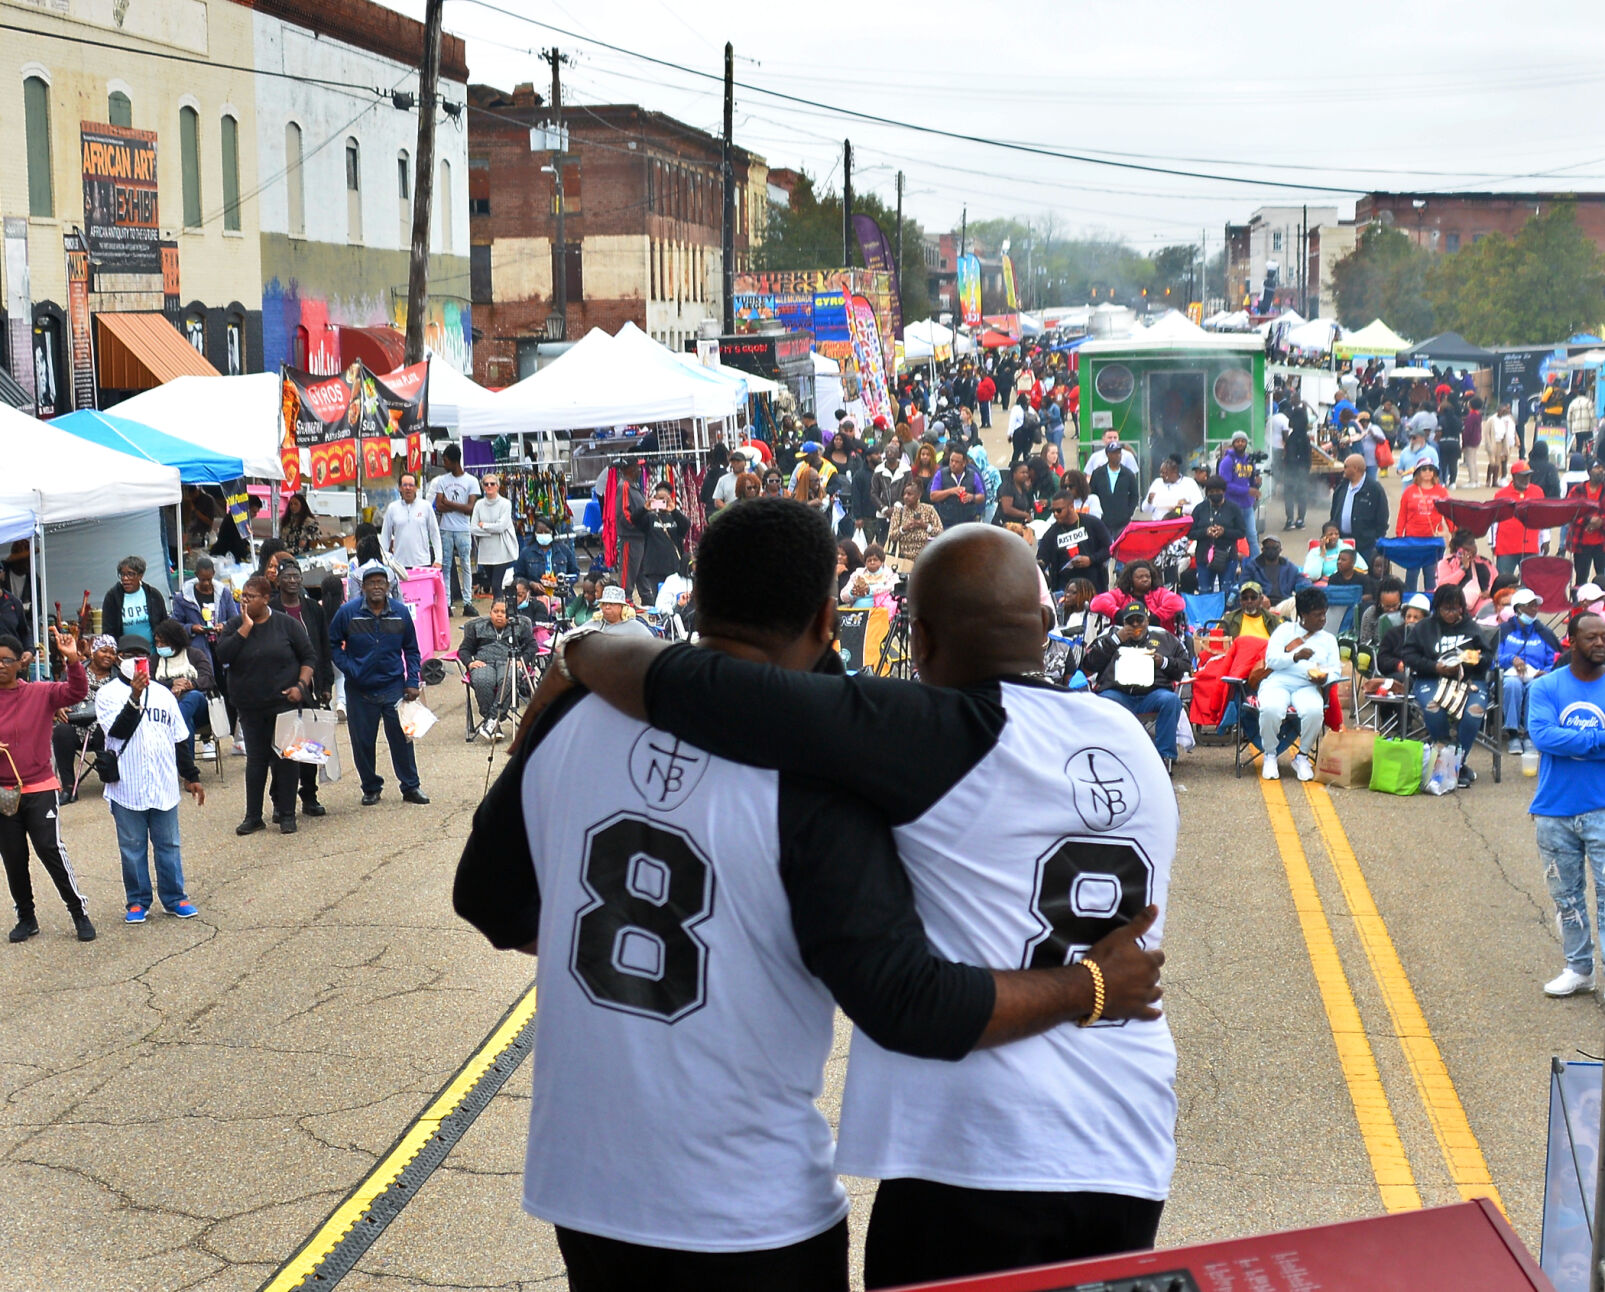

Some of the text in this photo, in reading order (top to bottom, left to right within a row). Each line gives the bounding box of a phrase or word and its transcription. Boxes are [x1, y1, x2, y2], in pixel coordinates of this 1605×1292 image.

[83, 141, 155, 180] AFRICAN ART
[116, 186, 158, 223] EXHIBIT
[90, 225, 109, 239] AFRICAN
[109, 226, 129, 241] ANTIQUITY
[756, 270, 829, 283] TURKEY
[767, 281, 818, 294] LEGS
[736, 295, 772, 304] TURKEY
[308, 383, 344, 405] GYROS
[1059, 535, 1072, 545] JUST
[1073, 530, 1083, 540] DO
[1566, 715, 1599, 731] Angelic
[569, 809, 716, 1025] 8
[1020, 834, 1154, 1028] 8
